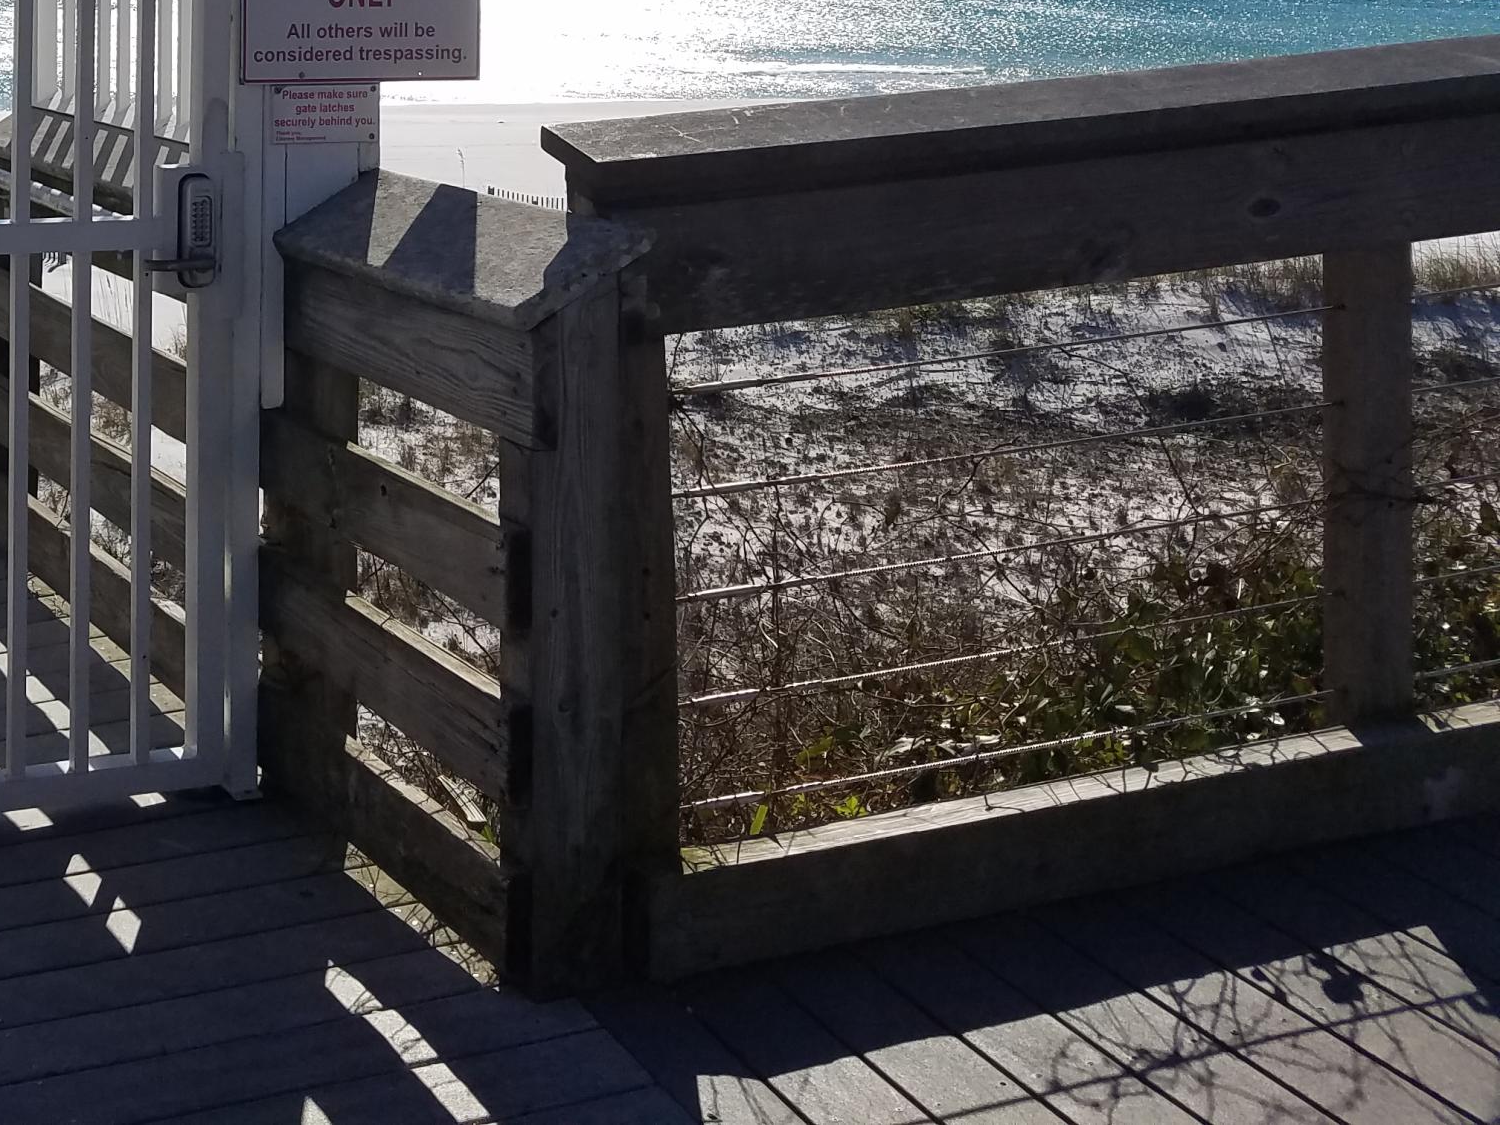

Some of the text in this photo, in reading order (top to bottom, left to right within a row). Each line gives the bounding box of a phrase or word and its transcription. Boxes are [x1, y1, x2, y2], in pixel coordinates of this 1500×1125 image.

[287, 23, 436, 39] All others will be
[254, 45, 467, 64] considered trespassing.
[282, 89, 368, 99] Please make sure
[295, 103, 354, 115] gate latches
[274, 117, 315, 128] securely
[319, 116, 352, 126] behind
